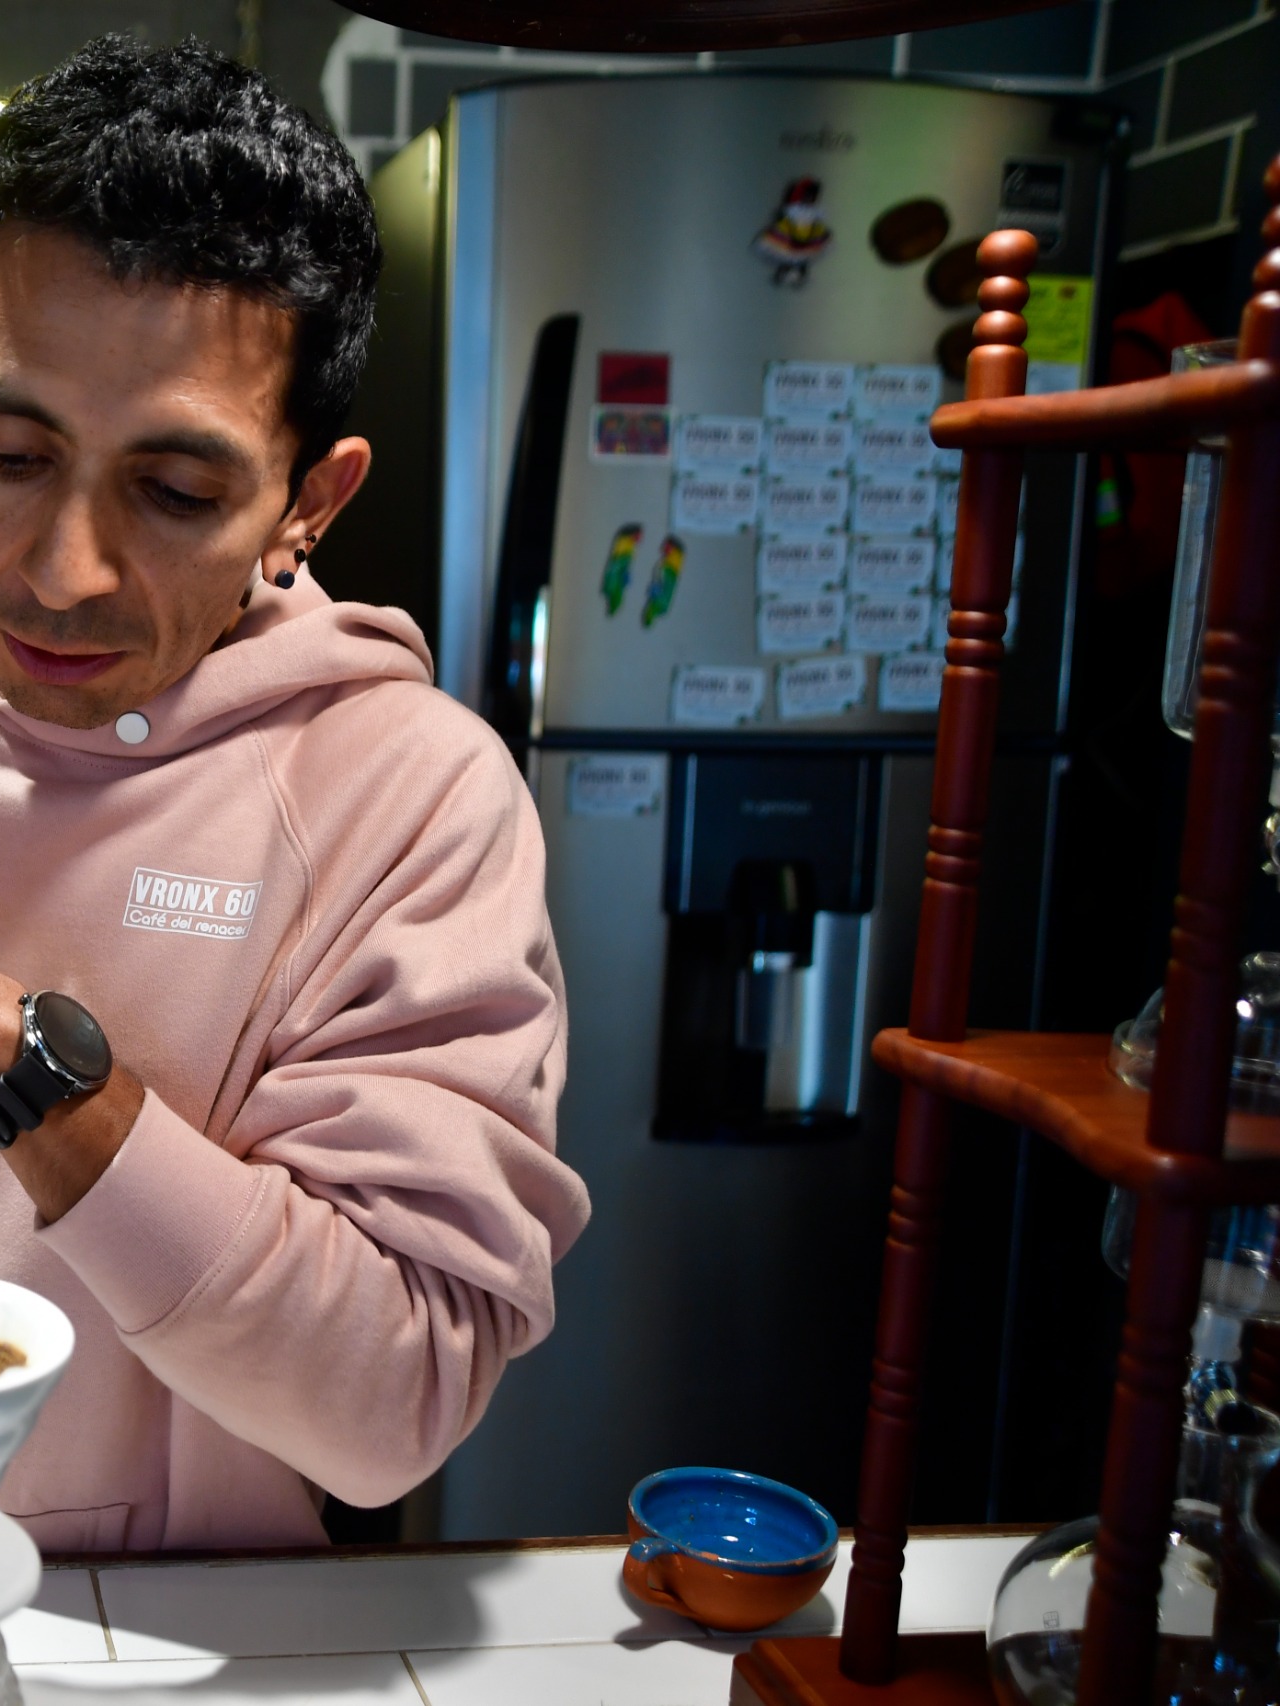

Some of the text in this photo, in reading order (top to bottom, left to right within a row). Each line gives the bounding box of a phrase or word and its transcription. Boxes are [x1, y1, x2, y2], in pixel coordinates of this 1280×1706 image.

[135, 874, 256, 916] VRONX 60
[129, 909, 248, 936] Café del renacer
